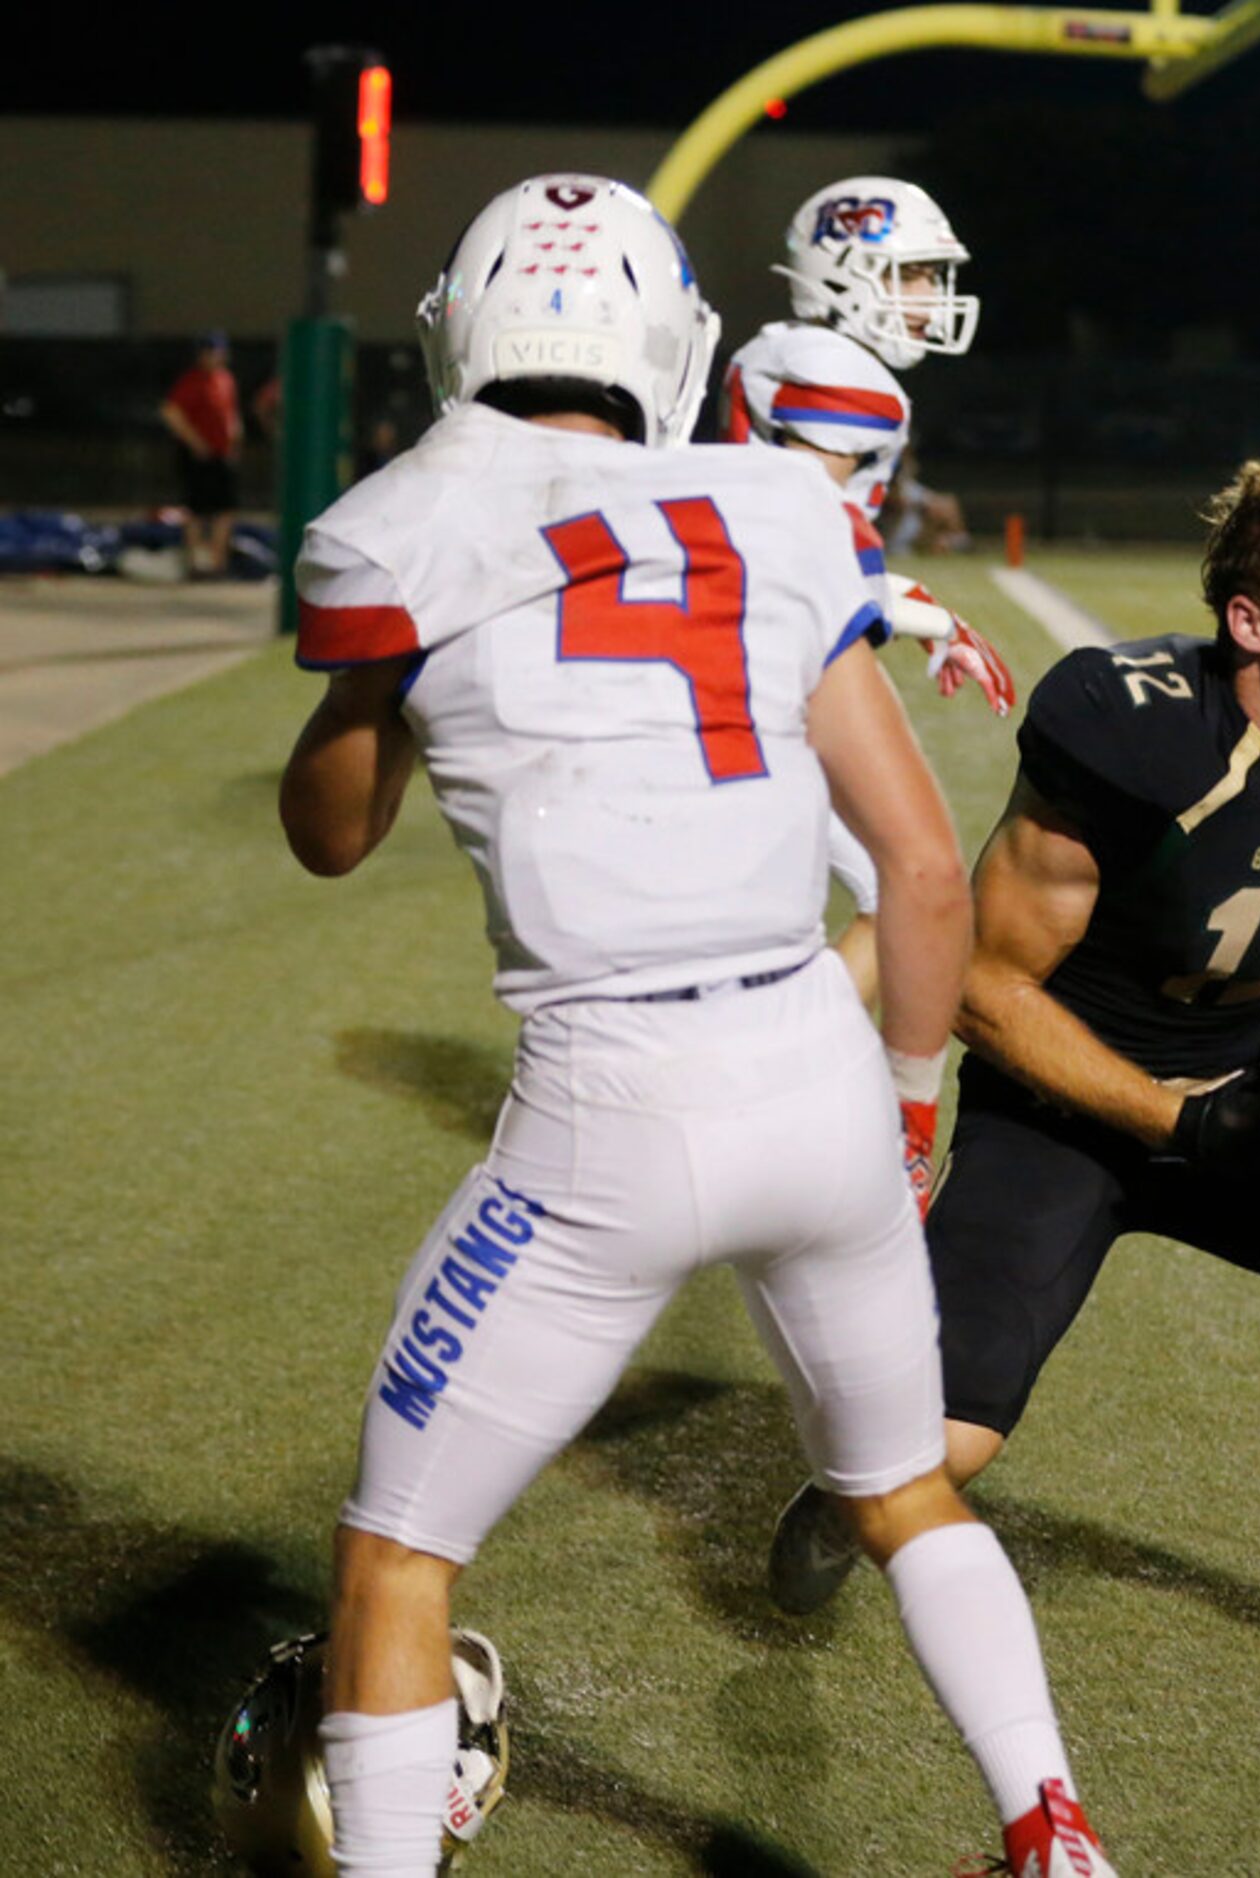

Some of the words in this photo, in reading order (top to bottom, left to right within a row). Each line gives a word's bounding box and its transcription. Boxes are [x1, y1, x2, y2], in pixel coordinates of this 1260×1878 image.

[550, 288, 563, 315] 4
[511, 340, 605, 364] VICIS
[539, 496, 771, 785] 4
[1112, 651, 1194, 705] 12
